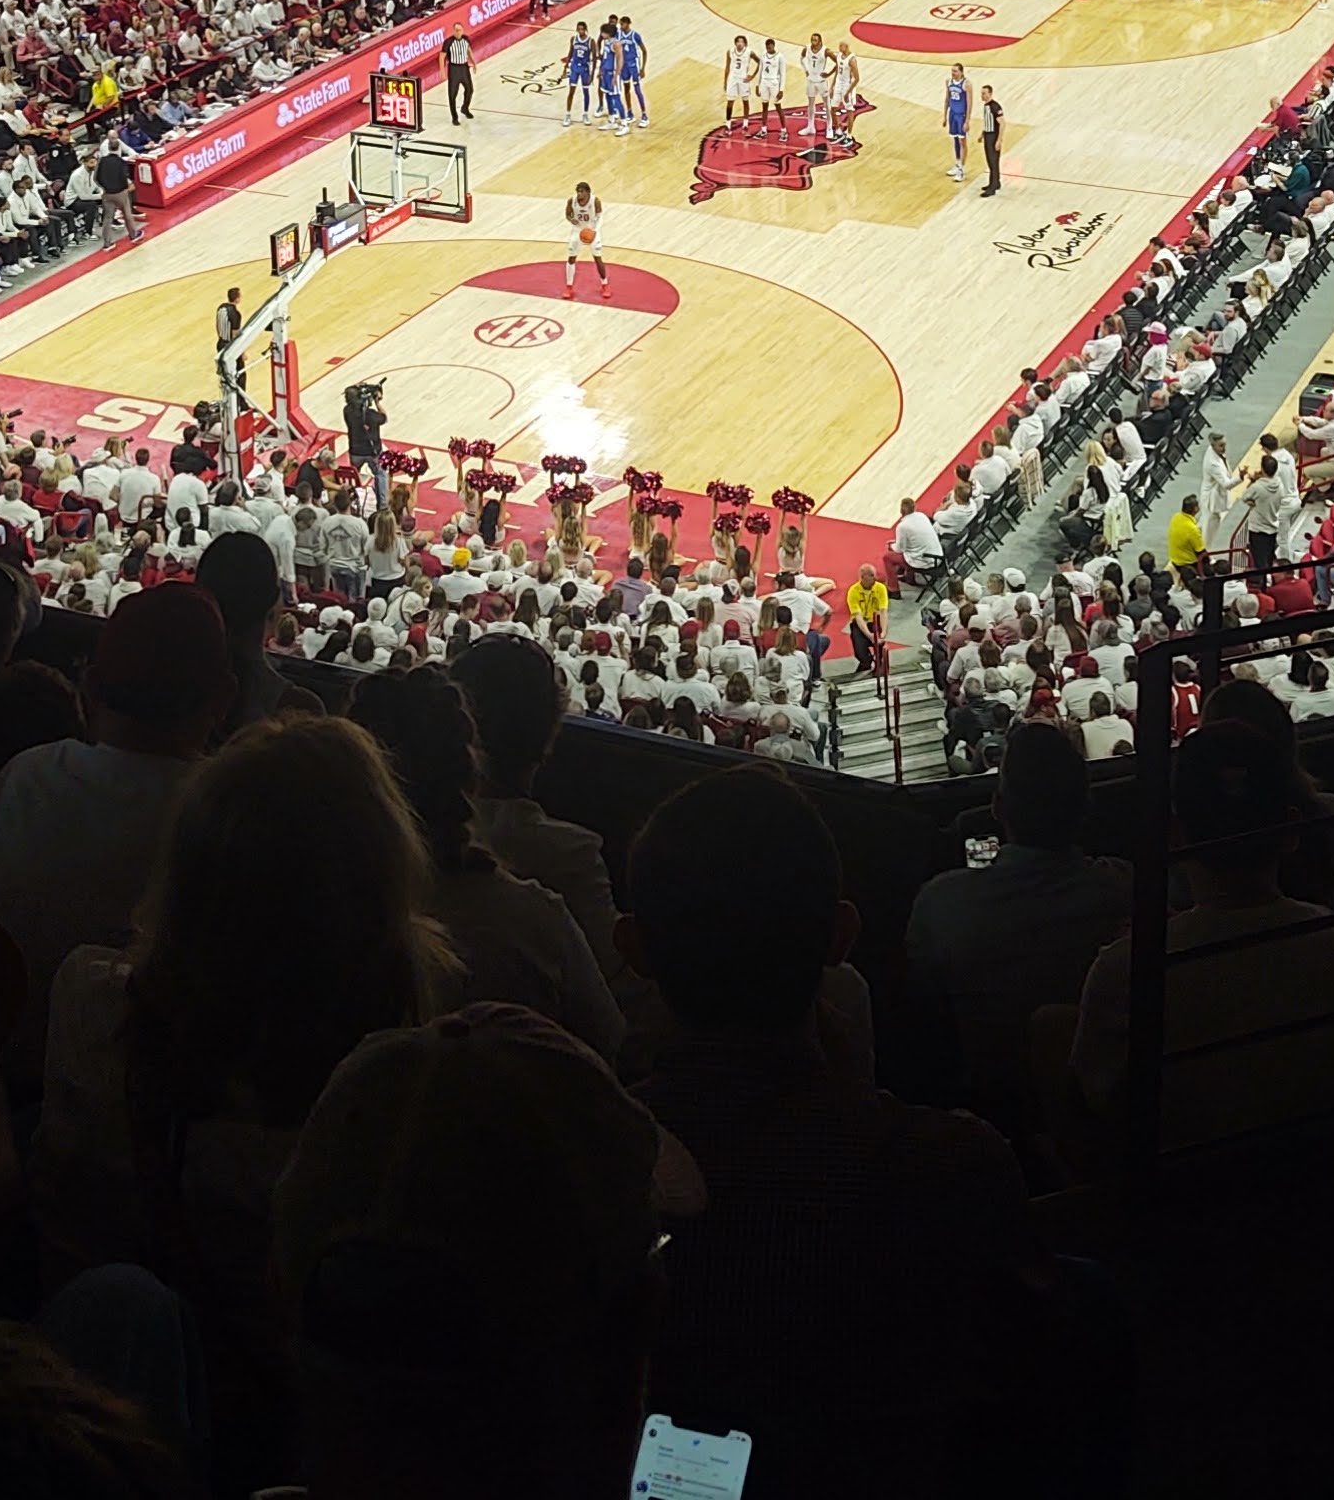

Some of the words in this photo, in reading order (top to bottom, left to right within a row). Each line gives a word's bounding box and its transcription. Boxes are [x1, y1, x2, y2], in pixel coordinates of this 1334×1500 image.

[933, 3, 993, 21] SEC
[577, 213, 590, 222] 20
[993, 224, 1052, 255] Nolan
[1027, 211, 1108, 272] Richardson
